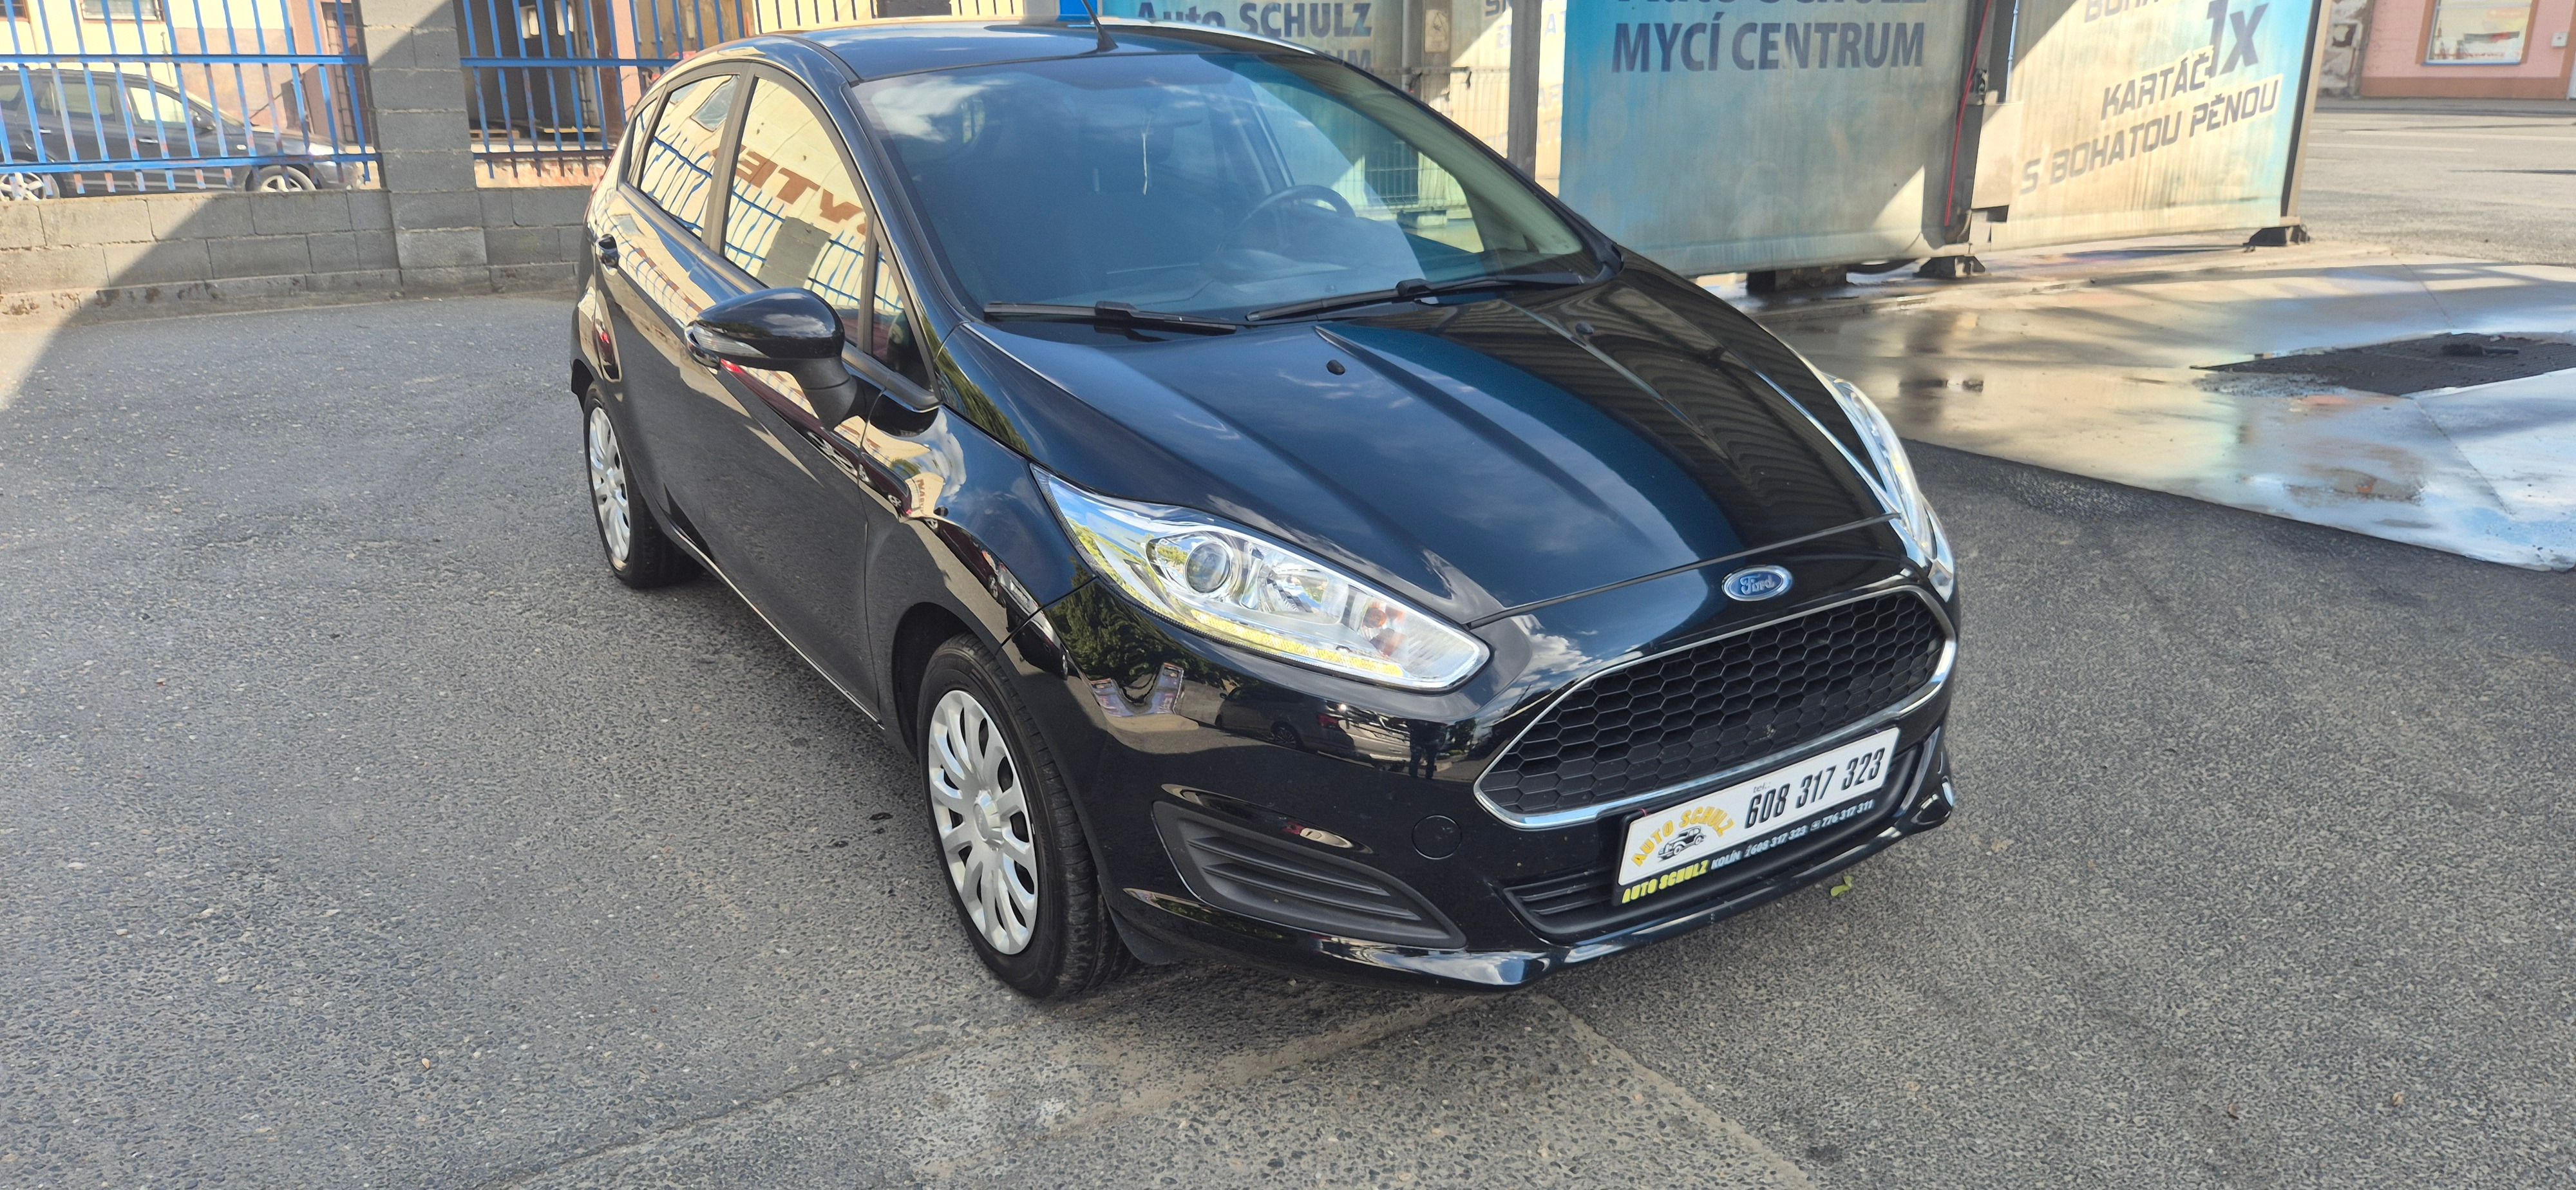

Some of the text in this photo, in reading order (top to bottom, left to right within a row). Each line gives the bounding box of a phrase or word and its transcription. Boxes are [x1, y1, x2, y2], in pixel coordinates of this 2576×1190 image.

[1240, 3, 1372, 37] SCHULZ
[1612, 12, 1725, 73] MYCÍ
[1732, 23, 1925, 71] CENTRUM
[2101, 52, 2211, 120] KARTÁČ
[2020, 79, 2280, 194] S BOHATOU PĚNOU
[1740, 572, 1776, 595] Ford
[1744, 747, 1886, 829] 608 317 323
[1622, 878, 1658, 903] AUTO
[1658, 860, 1710, 890] SCHULZ
[1711, 849, 1741, 869] KOLÍN
[1770, 832, 1789, 848] 317
[1788, 825, 1809, 840] 323
[1821, 812, 1840, 827] 776
[1839, 805, 1857, 820] 317
[1856, 798, 1875, 814] 311
[1631, 806, 1736, 867] AUTO SCHULZ
